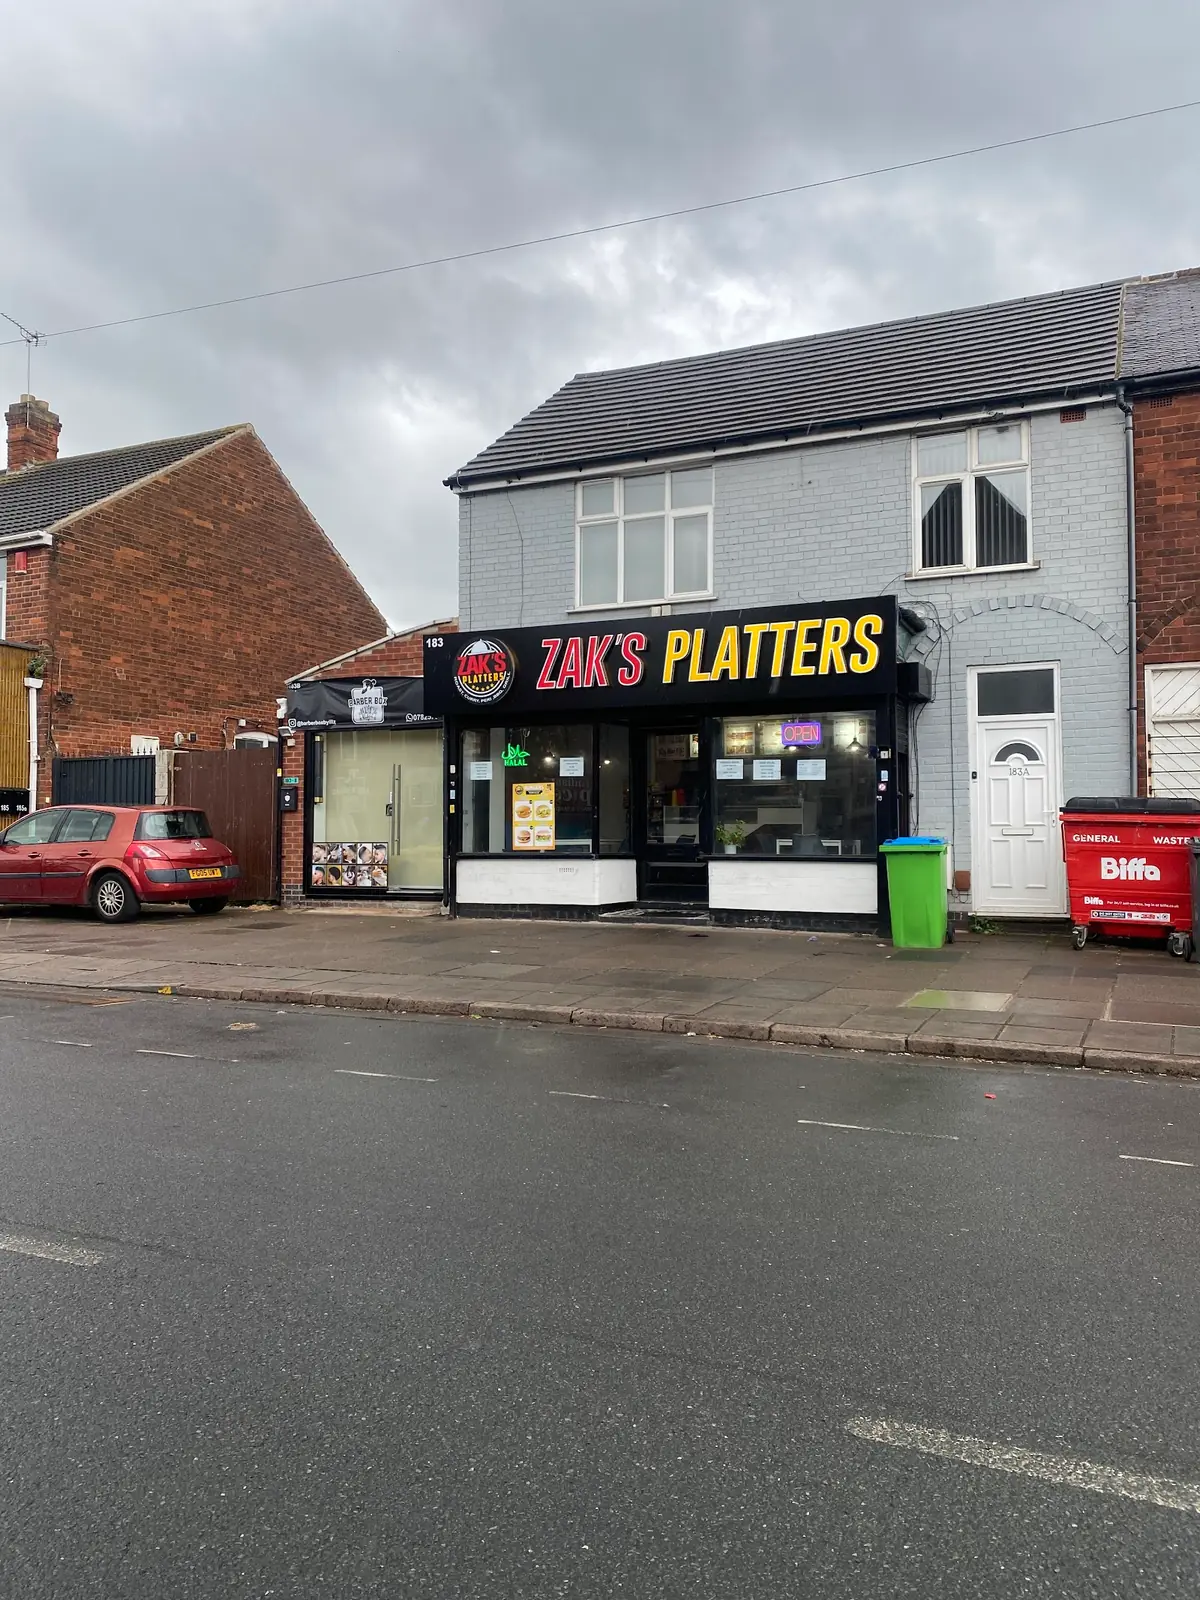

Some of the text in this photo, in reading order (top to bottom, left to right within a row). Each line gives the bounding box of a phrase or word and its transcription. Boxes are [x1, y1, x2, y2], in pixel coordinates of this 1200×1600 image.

[426, 637, 444, 648] 183
[536, 614, 883, 690] ZAK'S PLATTERS
[457, 652, 507, 675] ZAK'S
[462, 672, 504, 684] PLATTERS
[348, 697, 387, 707] BARBER BOX
[784, 725, 819, 741] OPEN
[501, 743, 531, 759] حلال
[1009, 767, 1030, 776] 183A
[1073, 834, 1190, 845] GENERAL WASTE
[1101, 857, 1161, 880] Biffa
[1084, 896, 1104, 905] Biffa
